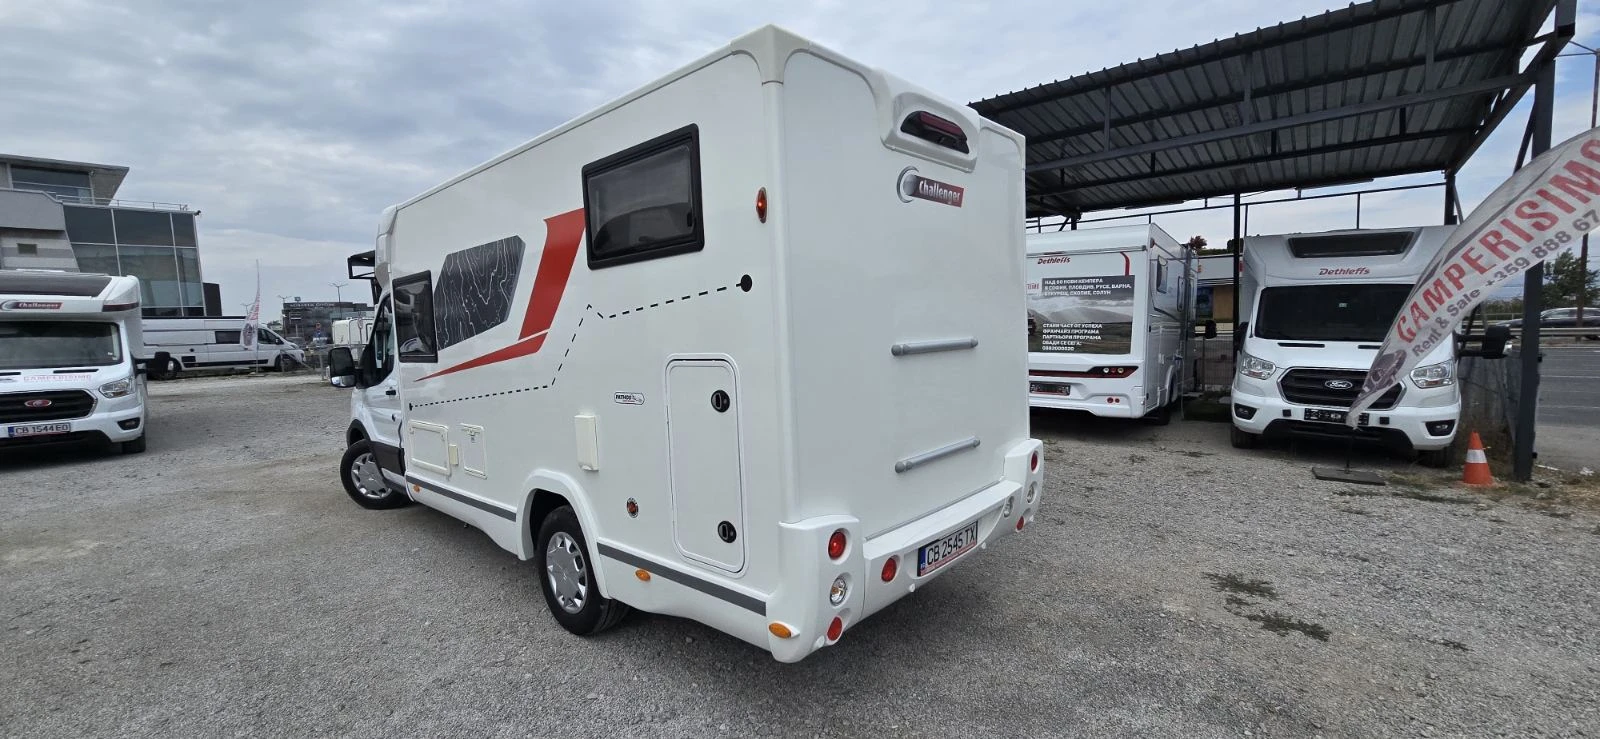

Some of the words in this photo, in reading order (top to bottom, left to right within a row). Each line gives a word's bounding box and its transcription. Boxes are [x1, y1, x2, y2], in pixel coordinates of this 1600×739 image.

[918, 180, 961, 204] Challenger
[1037, 257, 1071, 265] Dethleffs
[1319, 267, 1370, 276] Dethleffs
[1412, 328, 1442, 357] Rent
[1435, 316, 1449, 329] &
[1446, 288, 1481, 317] Sale
[1485, 256, 1531, 287] +359
[1531, 230, 1572, 259] 888
[32, 425, 55, 433] 1544
[927, 545, 940, 566] CB
[941, 532, 963, 559] 2545
[964, 525, 976, 546] TX
